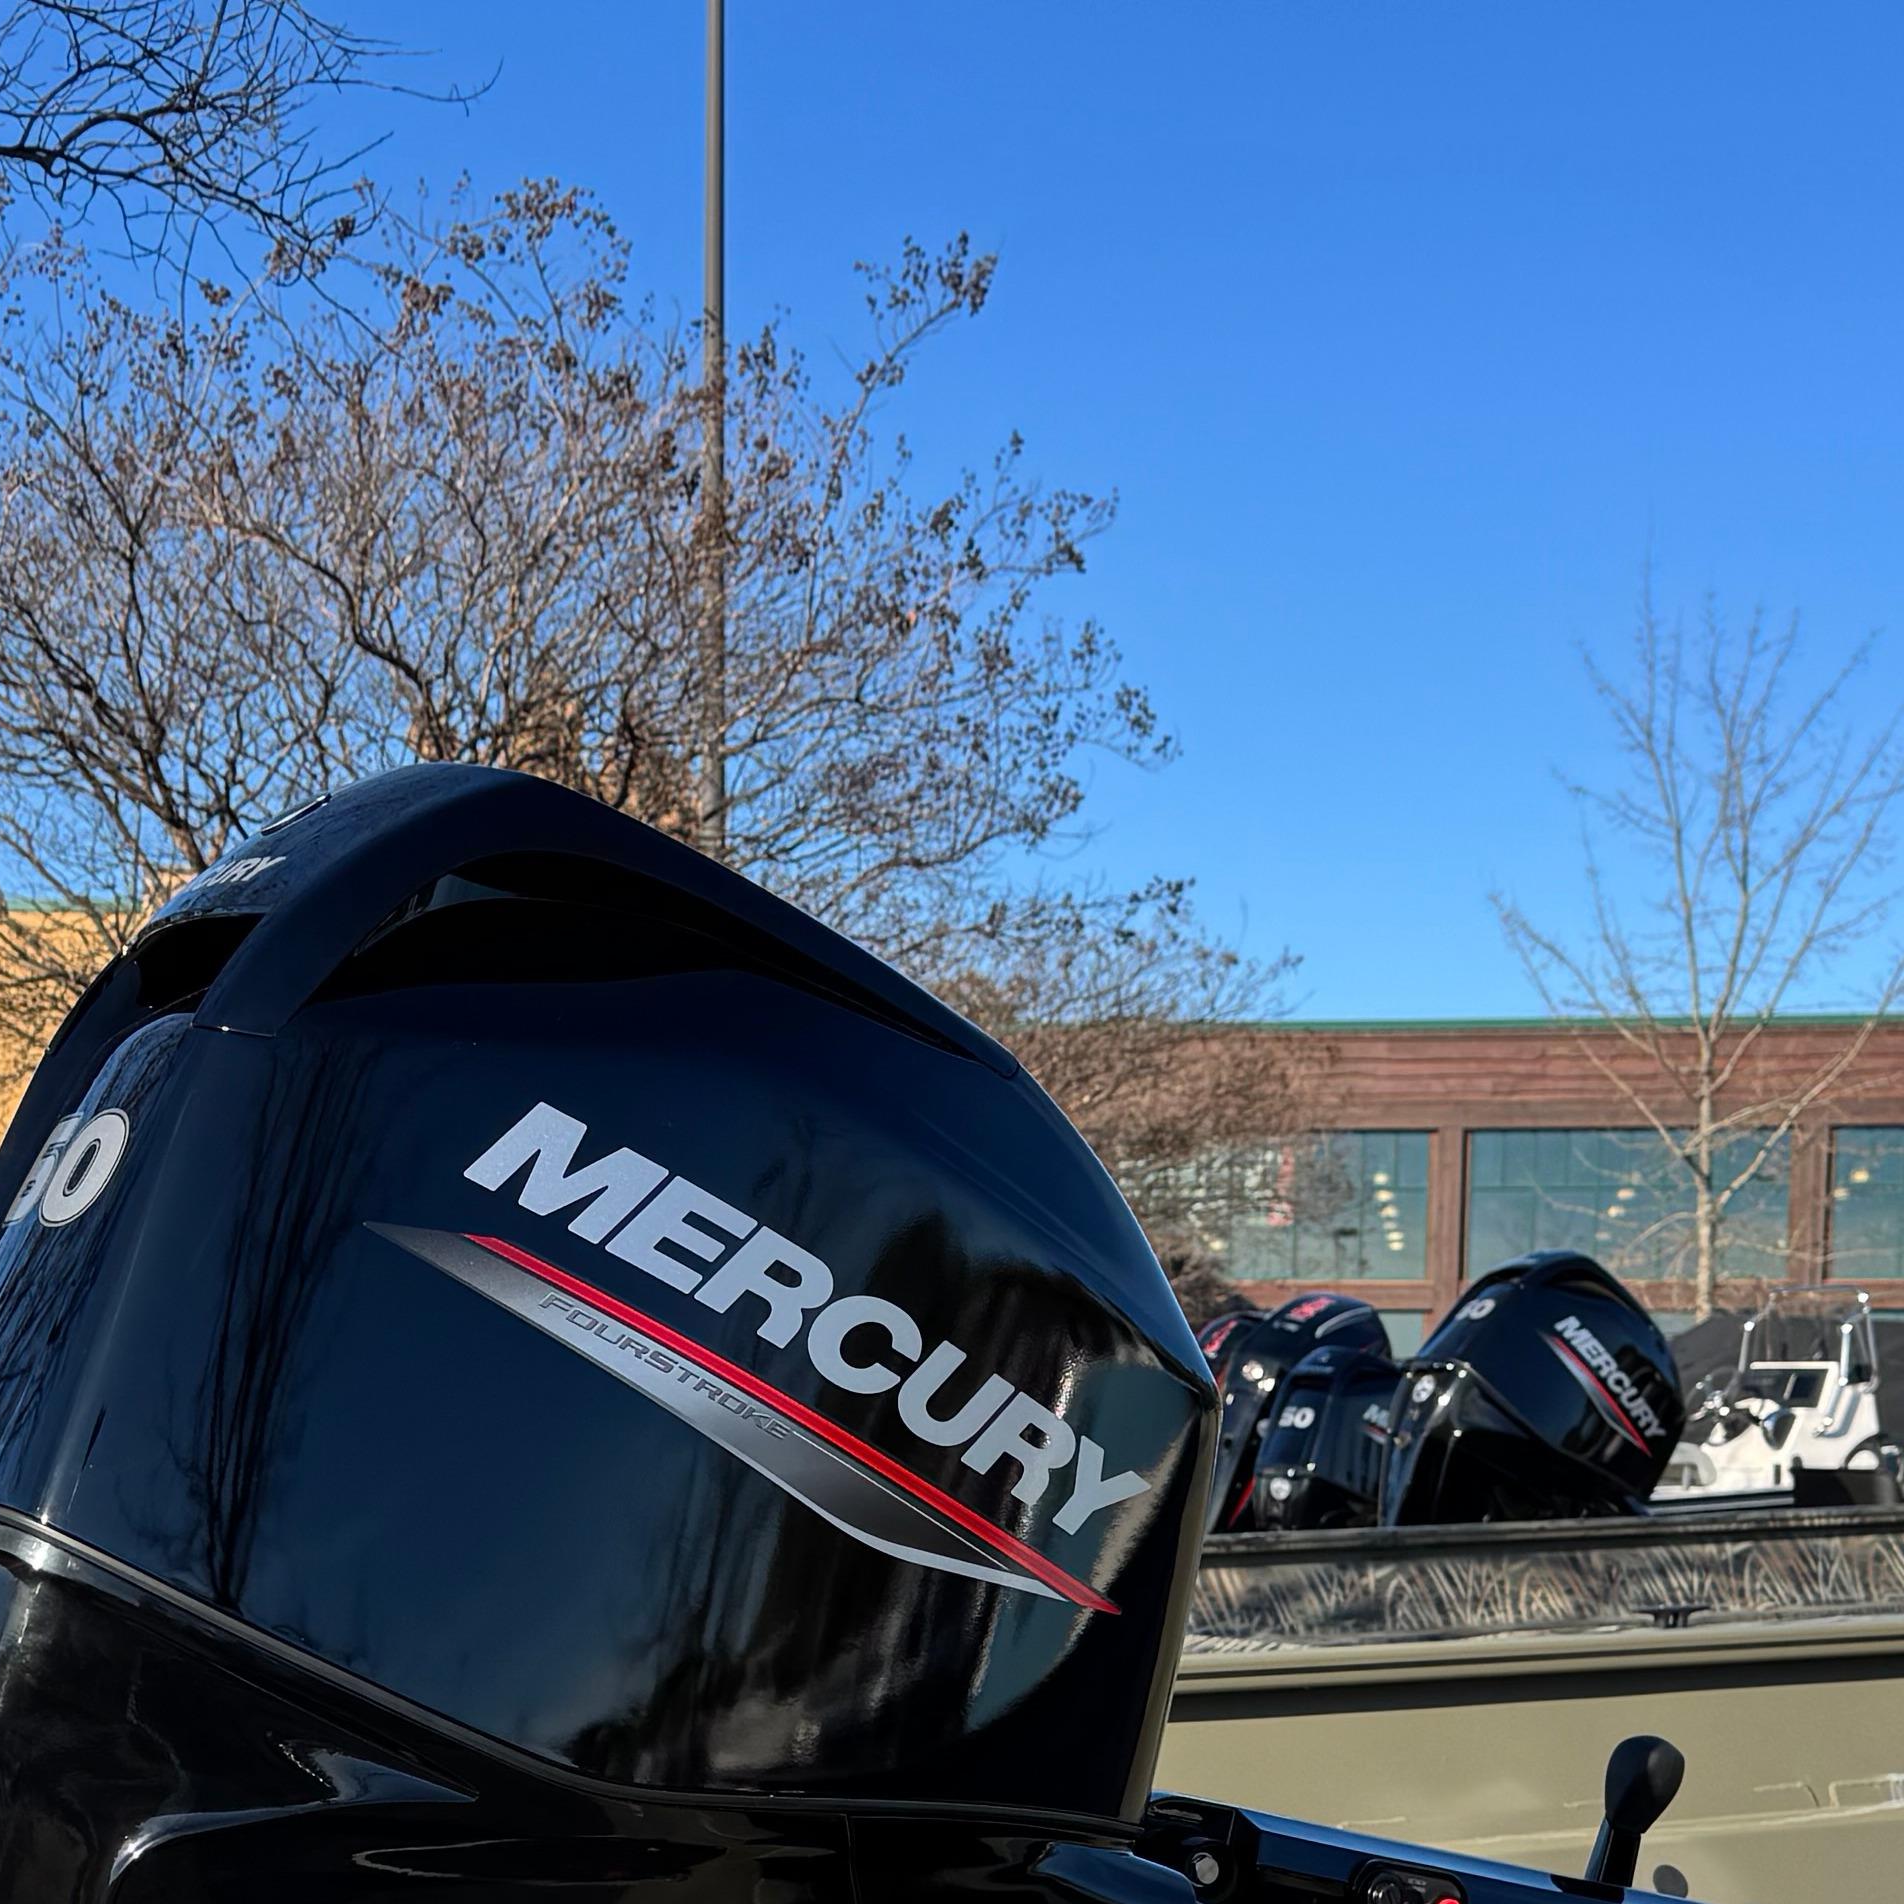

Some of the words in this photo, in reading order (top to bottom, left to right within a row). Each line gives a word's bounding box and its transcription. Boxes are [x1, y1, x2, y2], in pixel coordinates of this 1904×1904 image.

[462, 1098, 1154, 1536] MERCURY
[538, 1291, 793, 1440] FOURSTROKE
[1552, 1314, 1668, 1438] MERCURY
